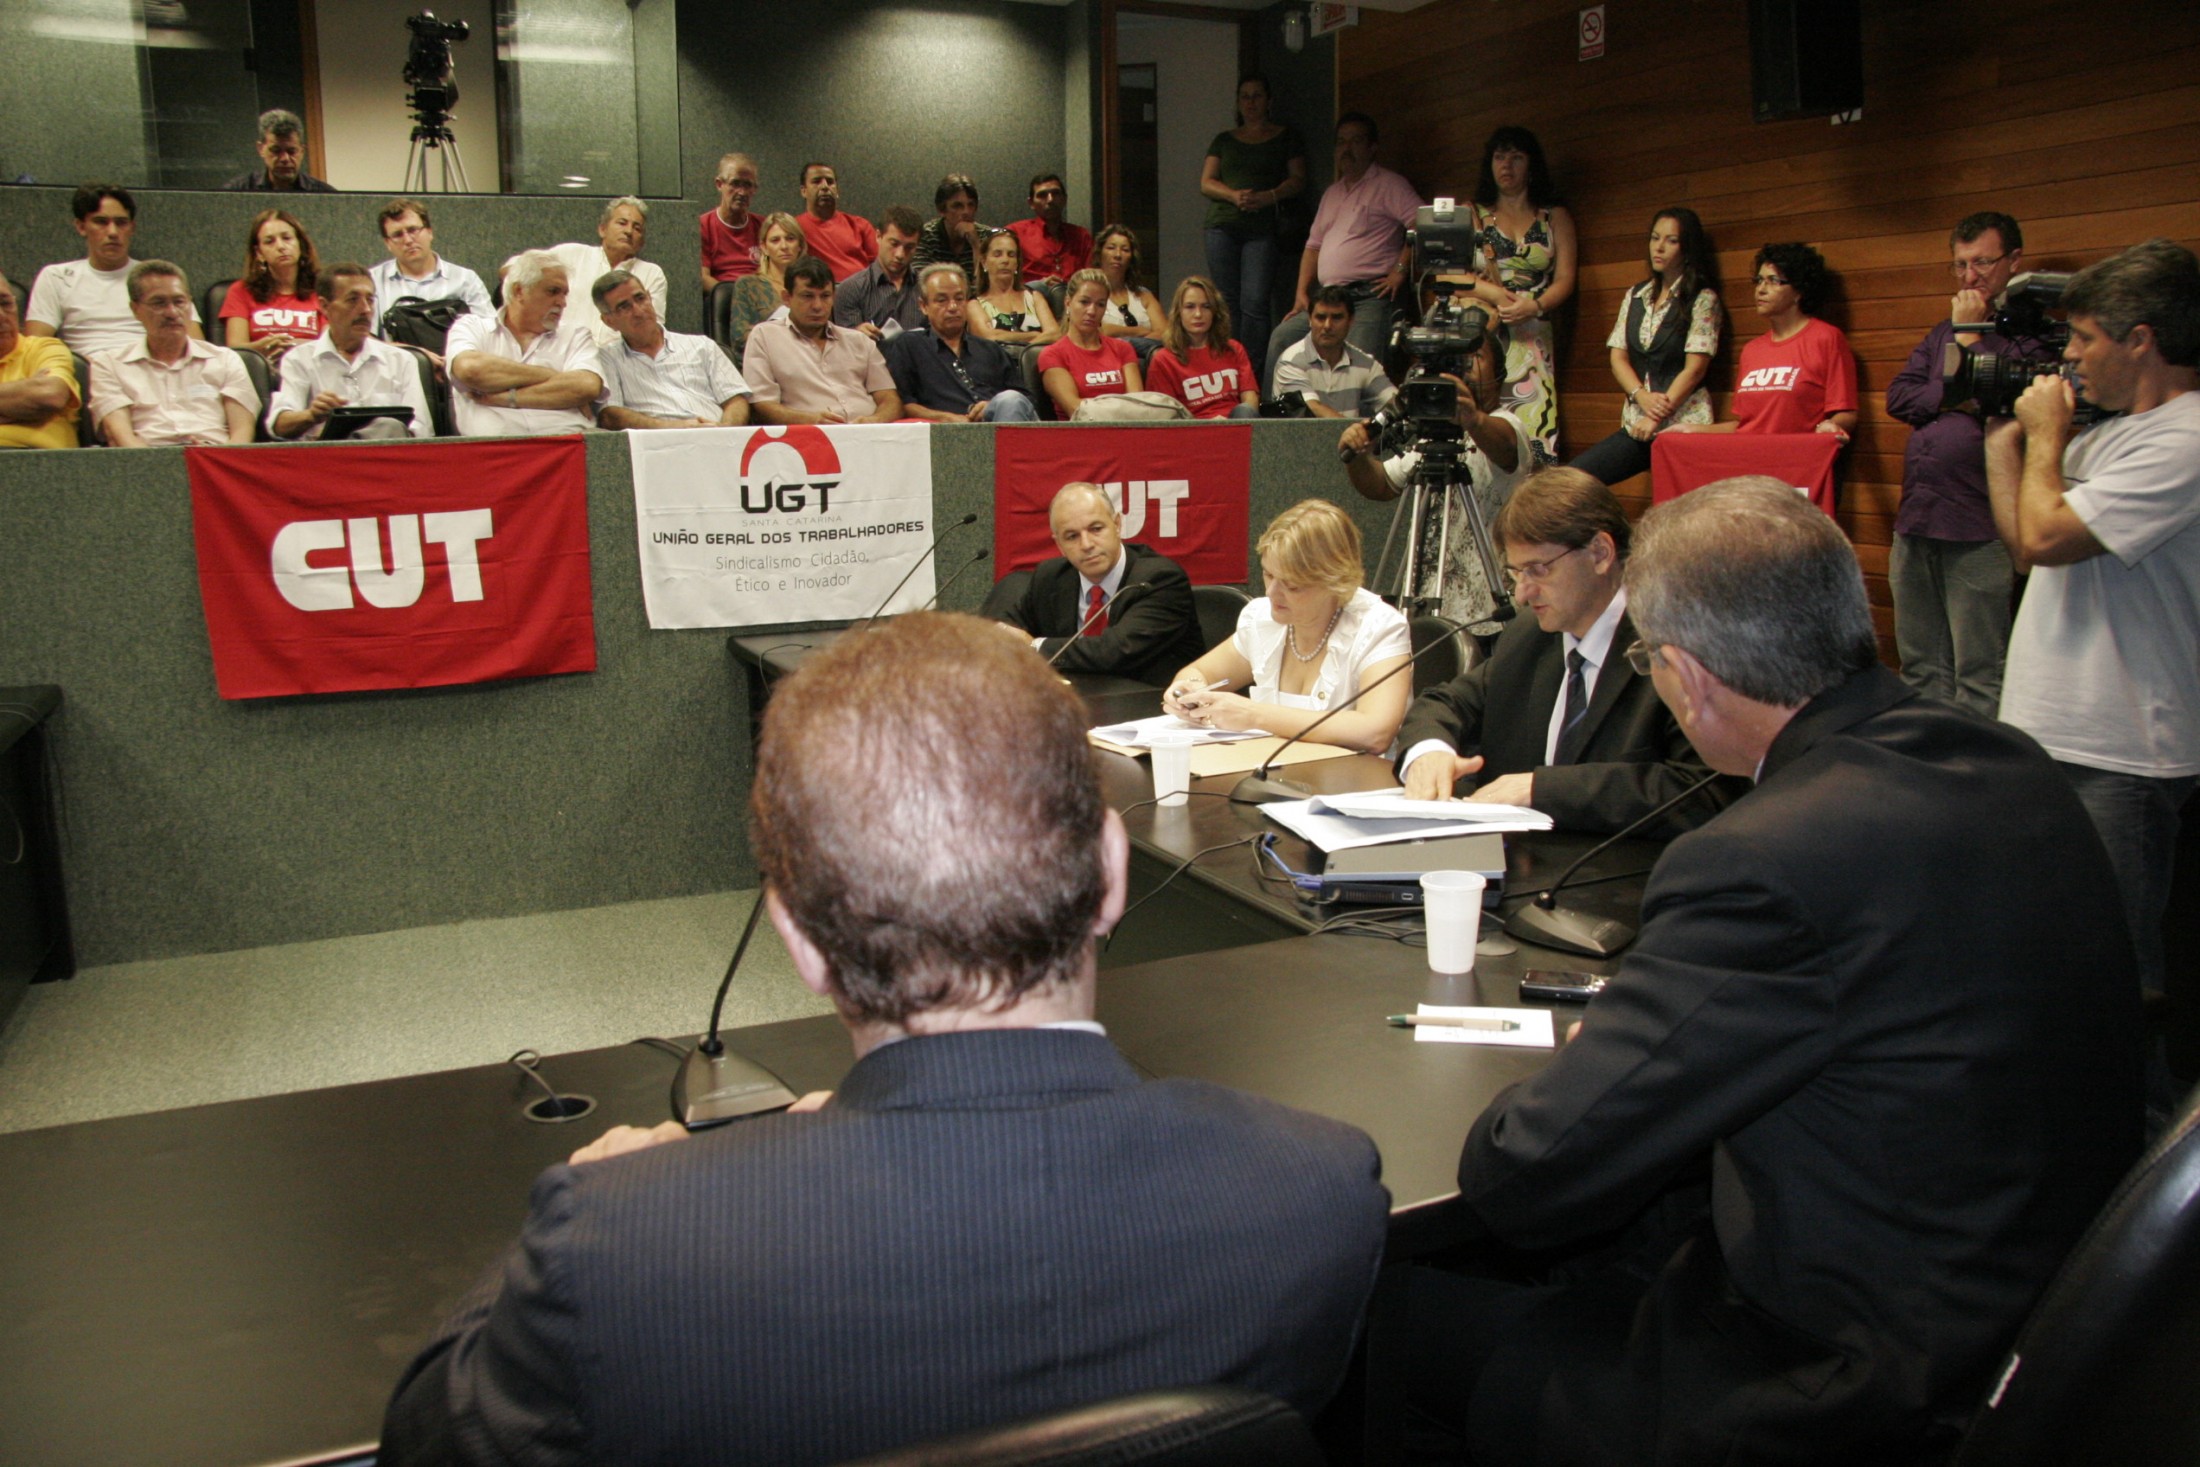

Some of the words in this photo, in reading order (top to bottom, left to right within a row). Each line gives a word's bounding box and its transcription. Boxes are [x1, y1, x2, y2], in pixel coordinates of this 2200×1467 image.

[253, 308, 312, 327] CUT
[1085, 370, 1117, 384] CUT
[1182, 368, 1239, 400] CUT
[1741, 366, 1793, 386] CUT
[741, 481, 840, 515] UGT
[1096, 479, 1190, 540] UT
[742, 519, 779, 528] SANTA
[786, 515, 843, 526] CATARINA
[653, 528, 699, 545] UNIÃO
[705, 532, 755, 546] GERAL
[761, 532, 792, 545] DOS
[798, 520, 925, 543] TRABALHADORES
[271, 508, 494, 612] CUT
[716, 555, 802, 570] Sindicalismo
[778, 579, 787, 591] e
[794, 573, 852, 590] Inovador
